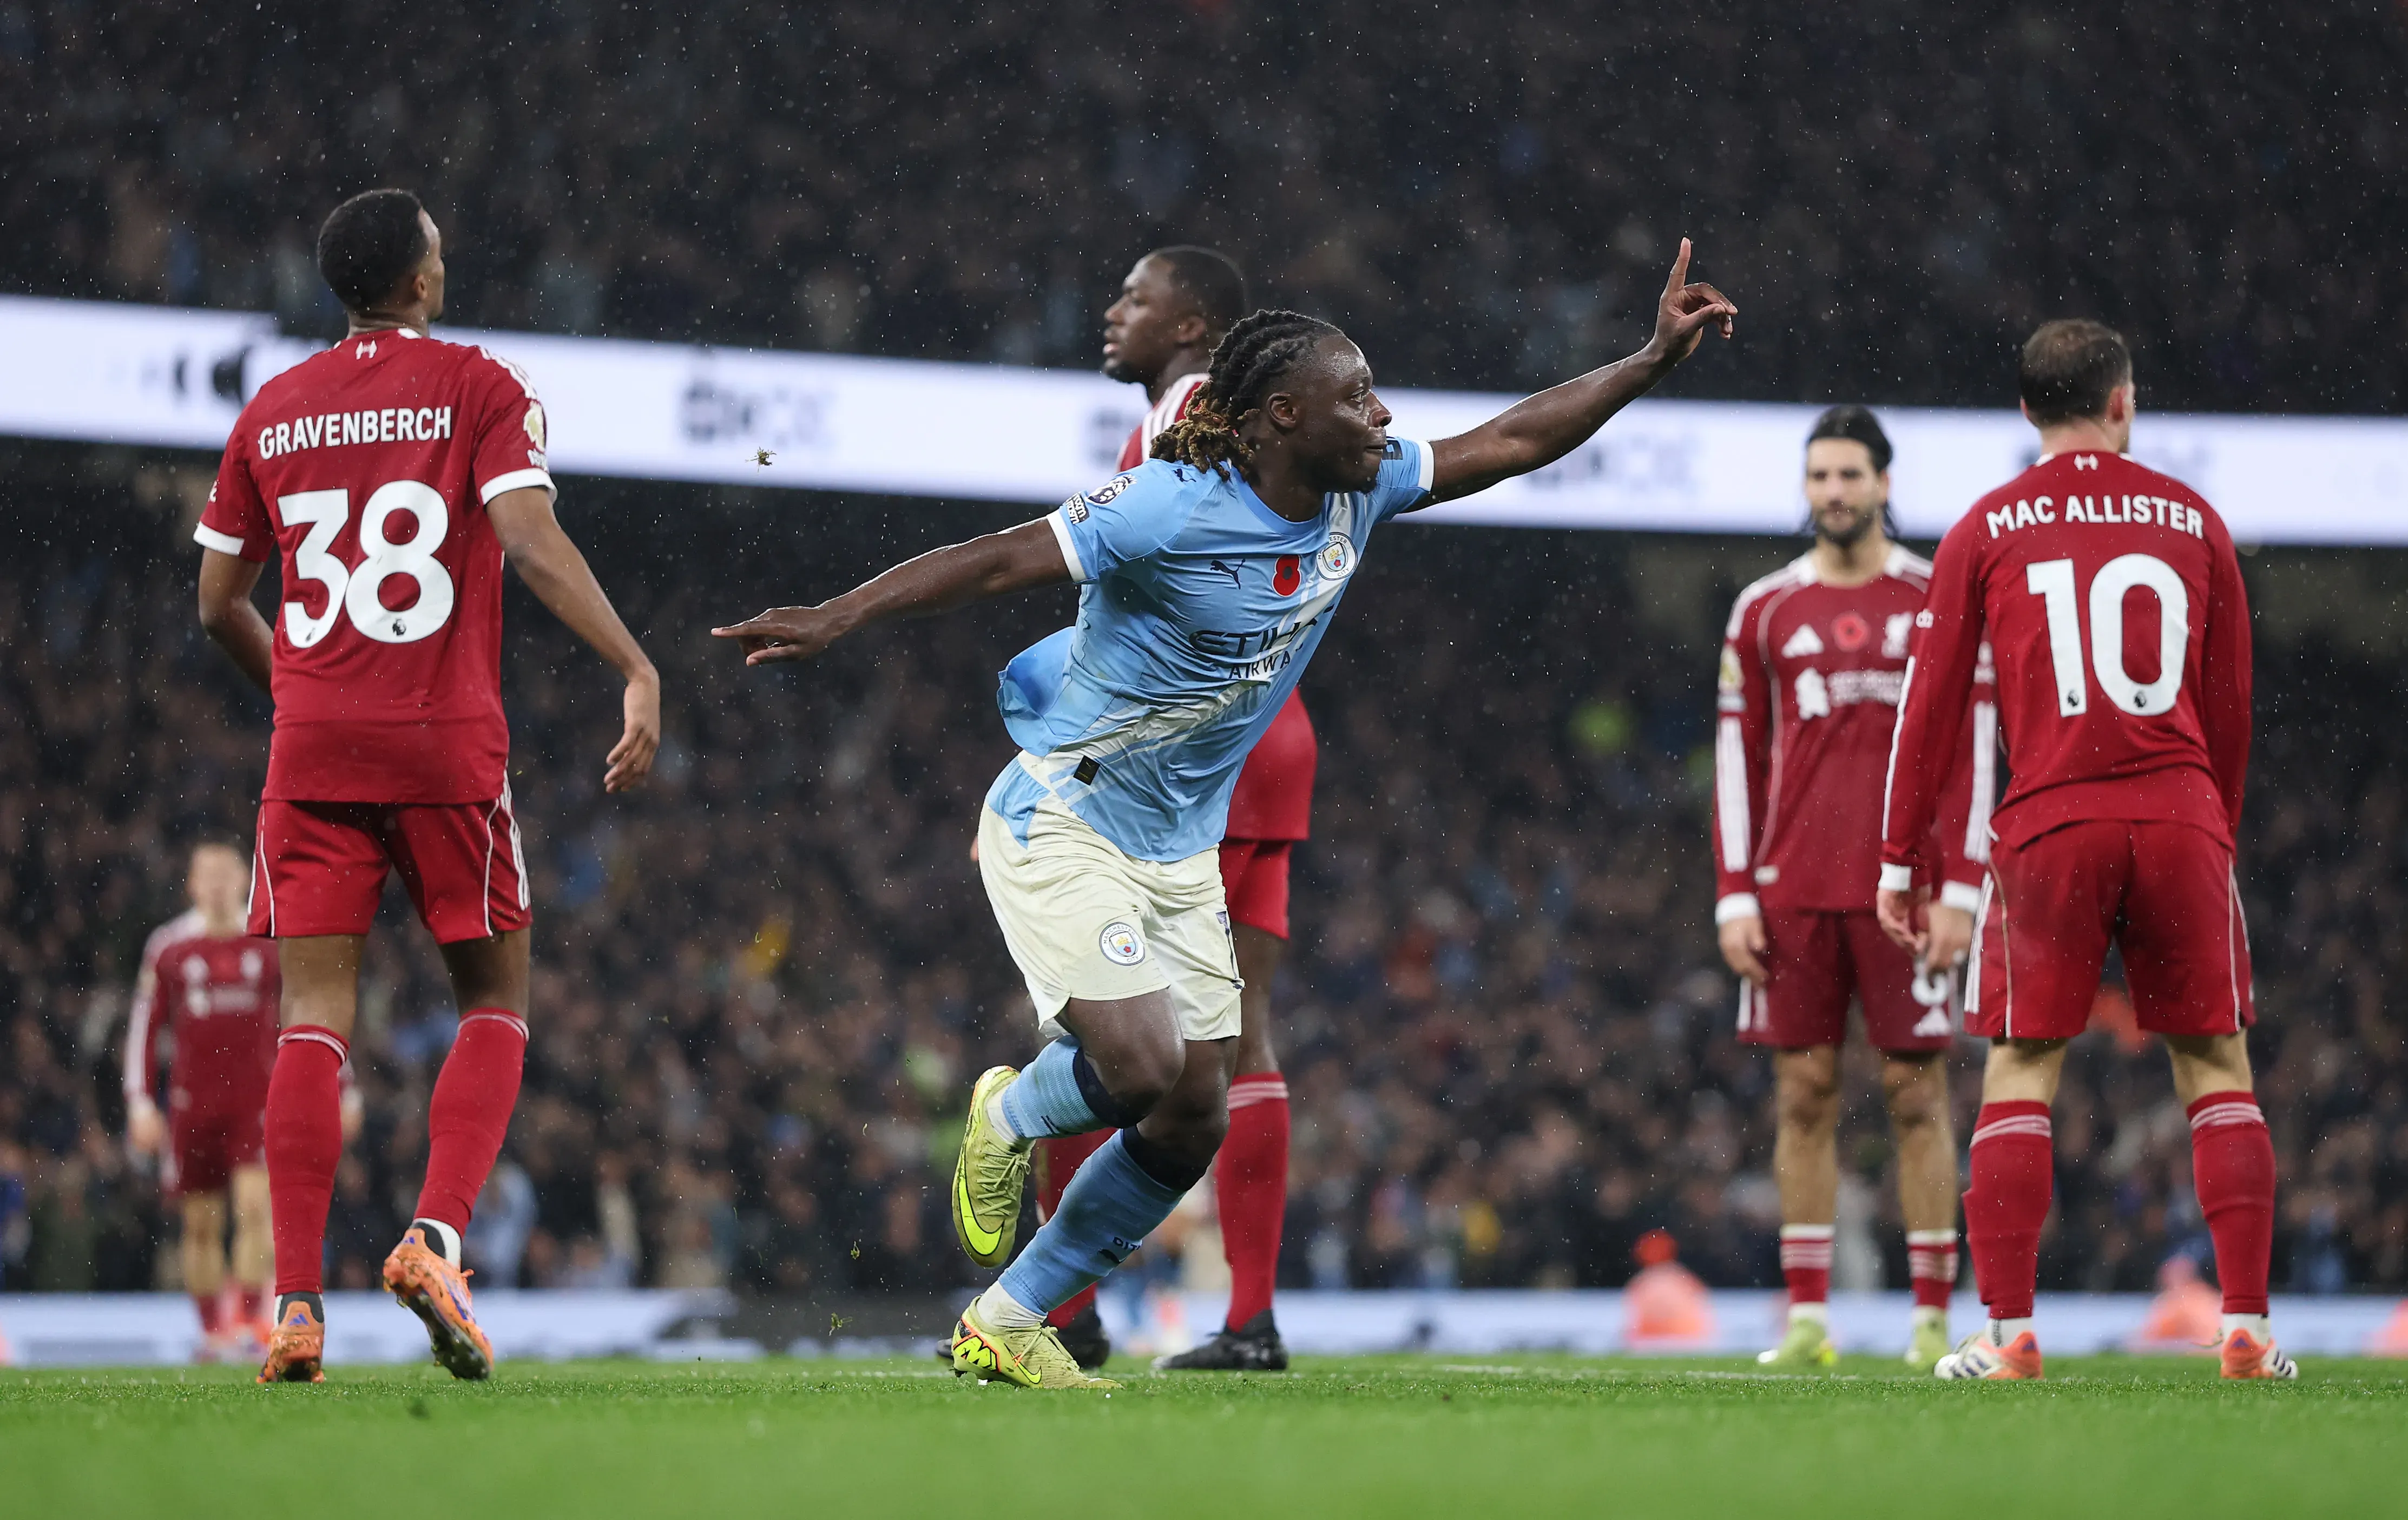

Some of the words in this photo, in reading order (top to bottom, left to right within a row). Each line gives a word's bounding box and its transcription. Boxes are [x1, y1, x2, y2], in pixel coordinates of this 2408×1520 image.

[259, 405, 451, 460] GRAVENBERCH
[1985, 495, 2056, 539] MAC
[2064, 495, 2204, 540] ALLISTER
[277, 479, 455, 649] 38
[1318, 536, 1347, 560] MESTER
[1337, 567, 1350, 577] CITY
[1189, 618, 1317, 657] ETIH
[2025, 552, 2190, 718] 10
[1229, 650, 1291, 679] AIRWA
[1103, 925, 1135, 944] MANCHESTER
